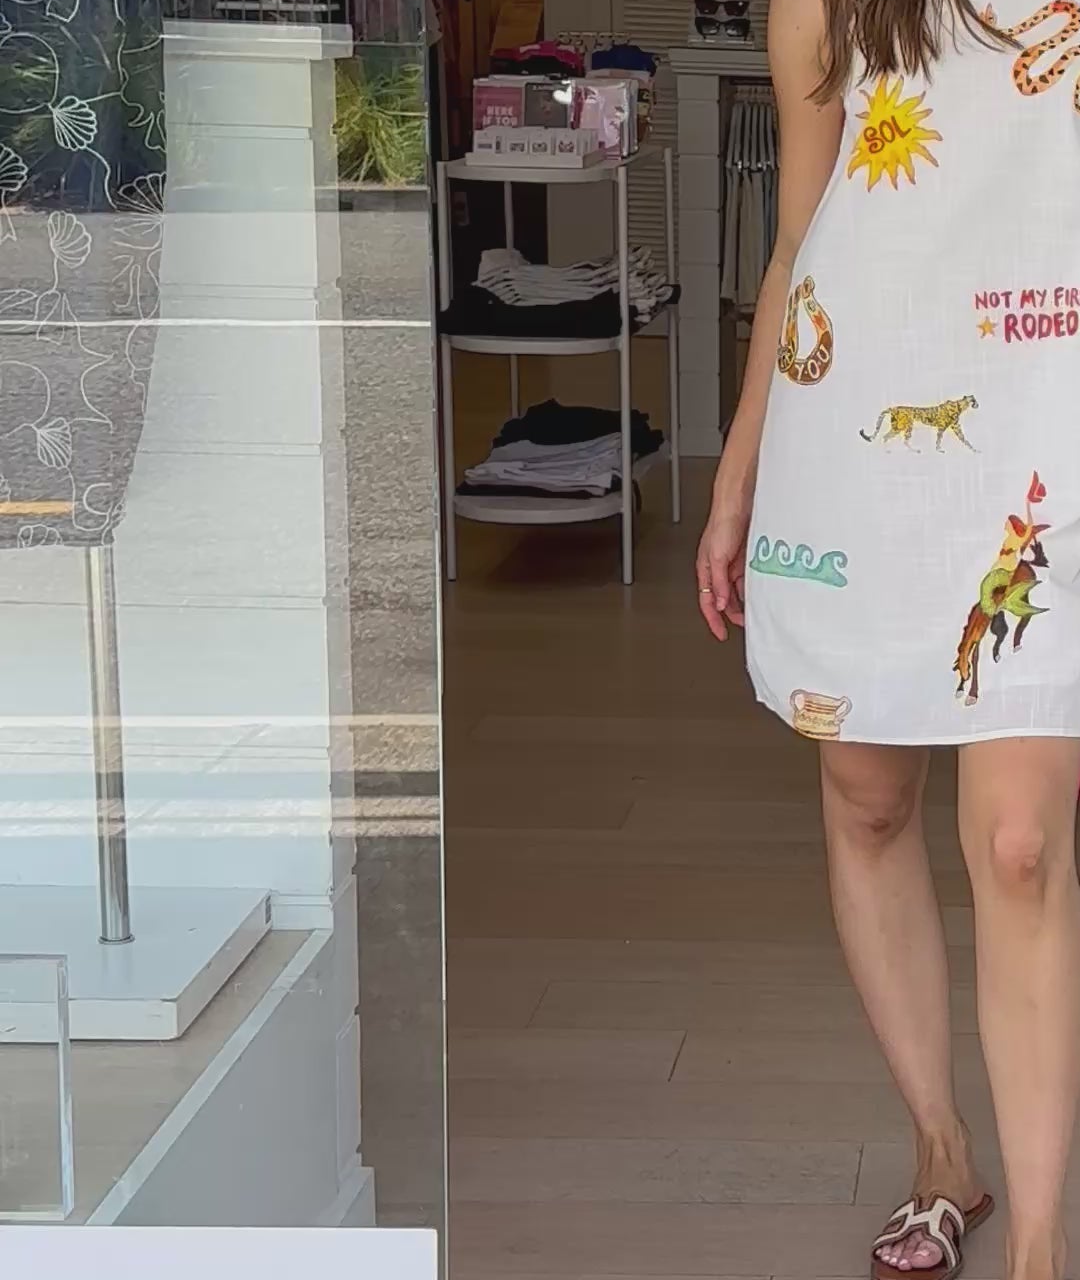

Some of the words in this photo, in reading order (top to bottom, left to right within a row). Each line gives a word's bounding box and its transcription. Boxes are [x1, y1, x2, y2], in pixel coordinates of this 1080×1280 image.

[863, 115, 912, 154] SOL
[975, 291, 1012, 309] NOT
[1020, 288, 1047, 309] MY
[1004, 310, 1079, 343] RODEO
